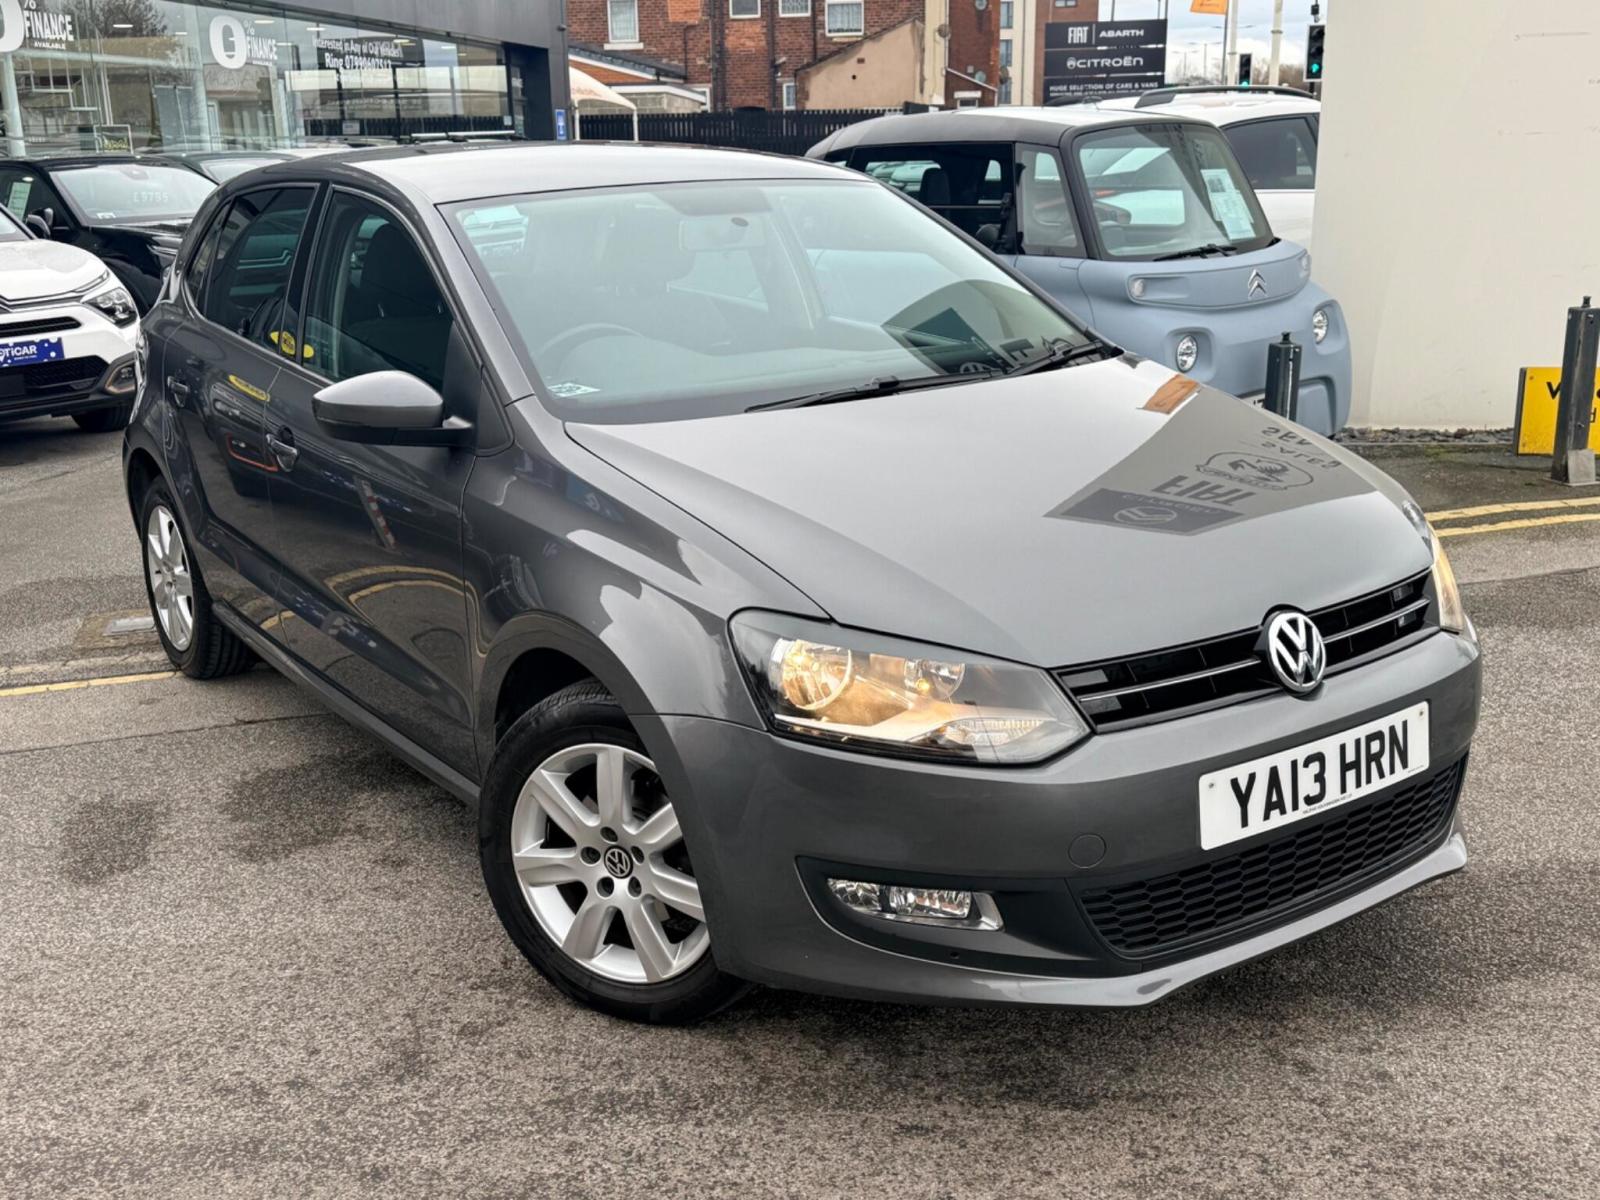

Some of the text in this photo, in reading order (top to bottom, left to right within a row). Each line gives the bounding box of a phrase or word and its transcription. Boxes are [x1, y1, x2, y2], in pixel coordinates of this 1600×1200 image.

[23, 10, 74, 41] FINANCE
[1067, 27, 1144, 44] FIAT ABARTH
[34, 41, 66, 50] AVAILABLE
[246, 36, 278, 60] FINANCE
[325, 53, 343, 71] Ring
[1076, 56, 1143, 69] CITROËN
[1230, 720, 1408, 829] YA13 HRN
